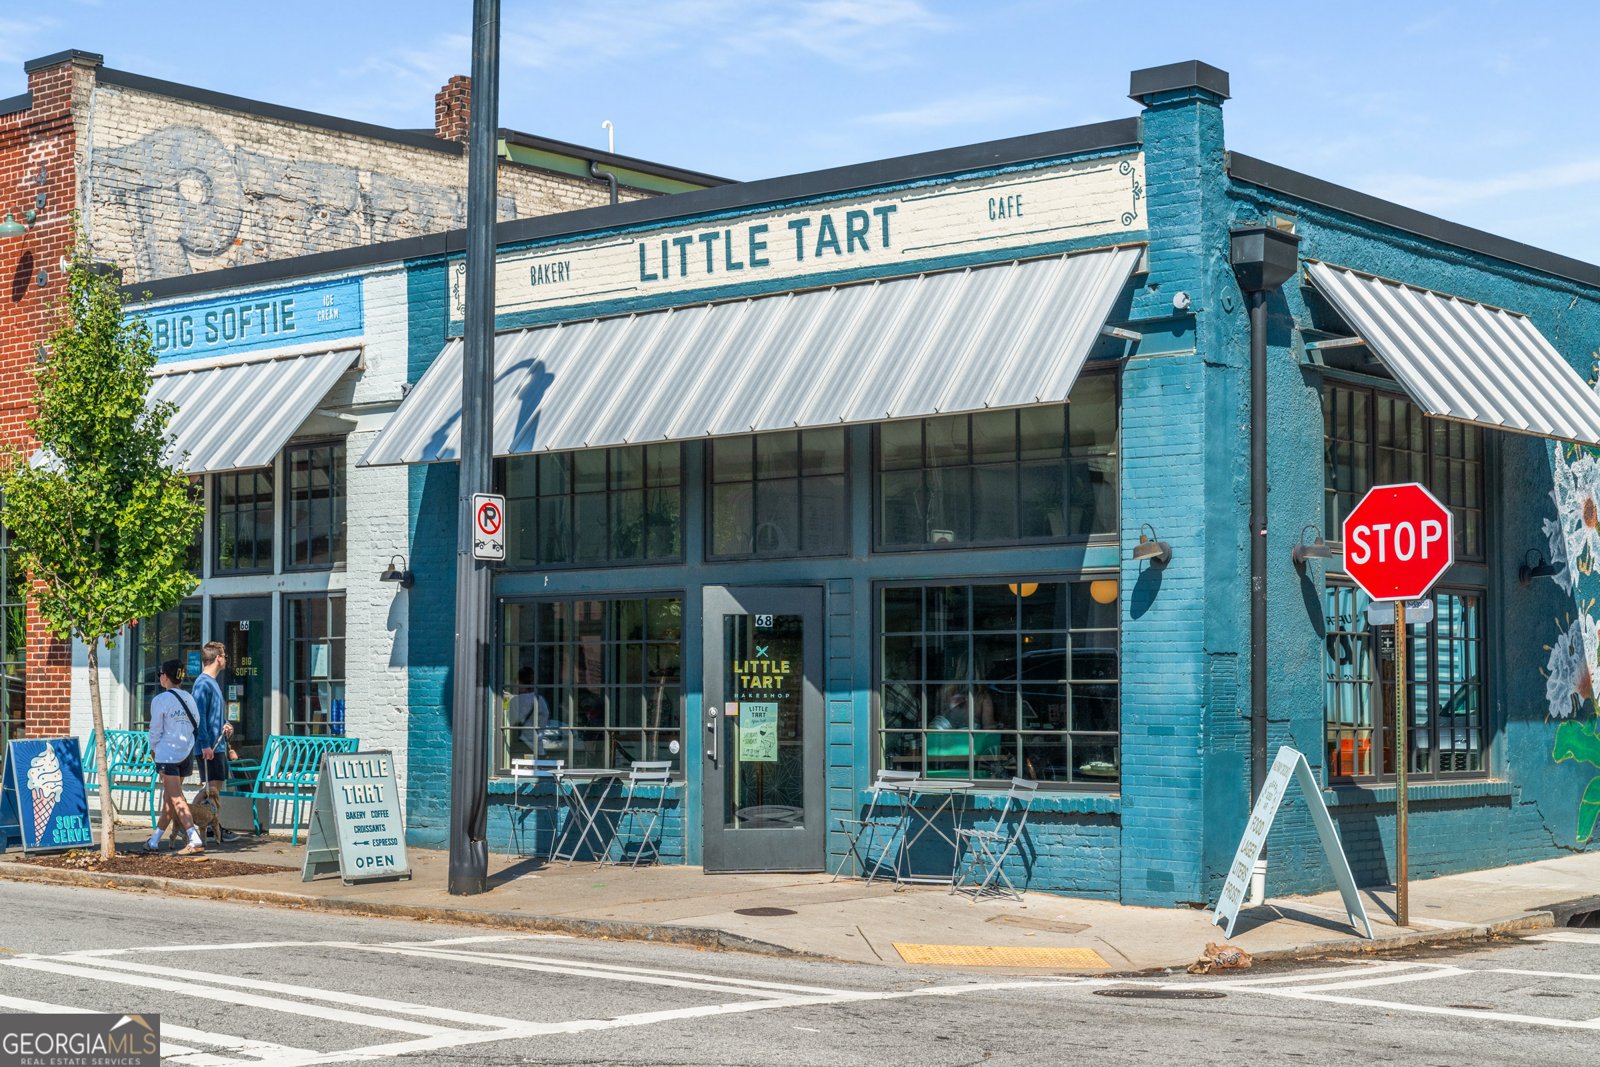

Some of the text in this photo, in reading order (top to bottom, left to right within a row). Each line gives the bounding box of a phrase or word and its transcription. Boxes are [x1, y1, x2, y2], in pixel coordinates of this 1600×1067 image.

[988, 194, 1024, 220] CAFE
[639, 204, 897, 282] LITTLE TART
[530, 261, 570, 286] BAKERY
[323, 294, 335, 305] ICE
[317, 308, 339, 321] CREAM
[155, 298, 296, 352] BIG SOFTIE
[1351, 519, 1442, 565] STOP
[240, 621, 249, 630] 66
[756, 615, 772, 626] 68
[241, 656, 252, 666] BIG
[734, 660, 790, 673] LITTLE
[235, 667, 258, 677] SOFTIE
[741, 675, 784, 689] TART
[334, 759, 388, 779] LITTLE
[342, 783, 384, 804] TART
[55, 814, 84, 829] SOFT
[345, 809, 390, 820] BAKERY COFFEE
[353, 824, 386, 834] CROISSANTS
[1250, 815, 1265, 836] FOOD
[52, 828, 90, 844] SERVE
[372, 837, 398, 847] ESPRESSO
[355, 854, 395, 868] OPEN
